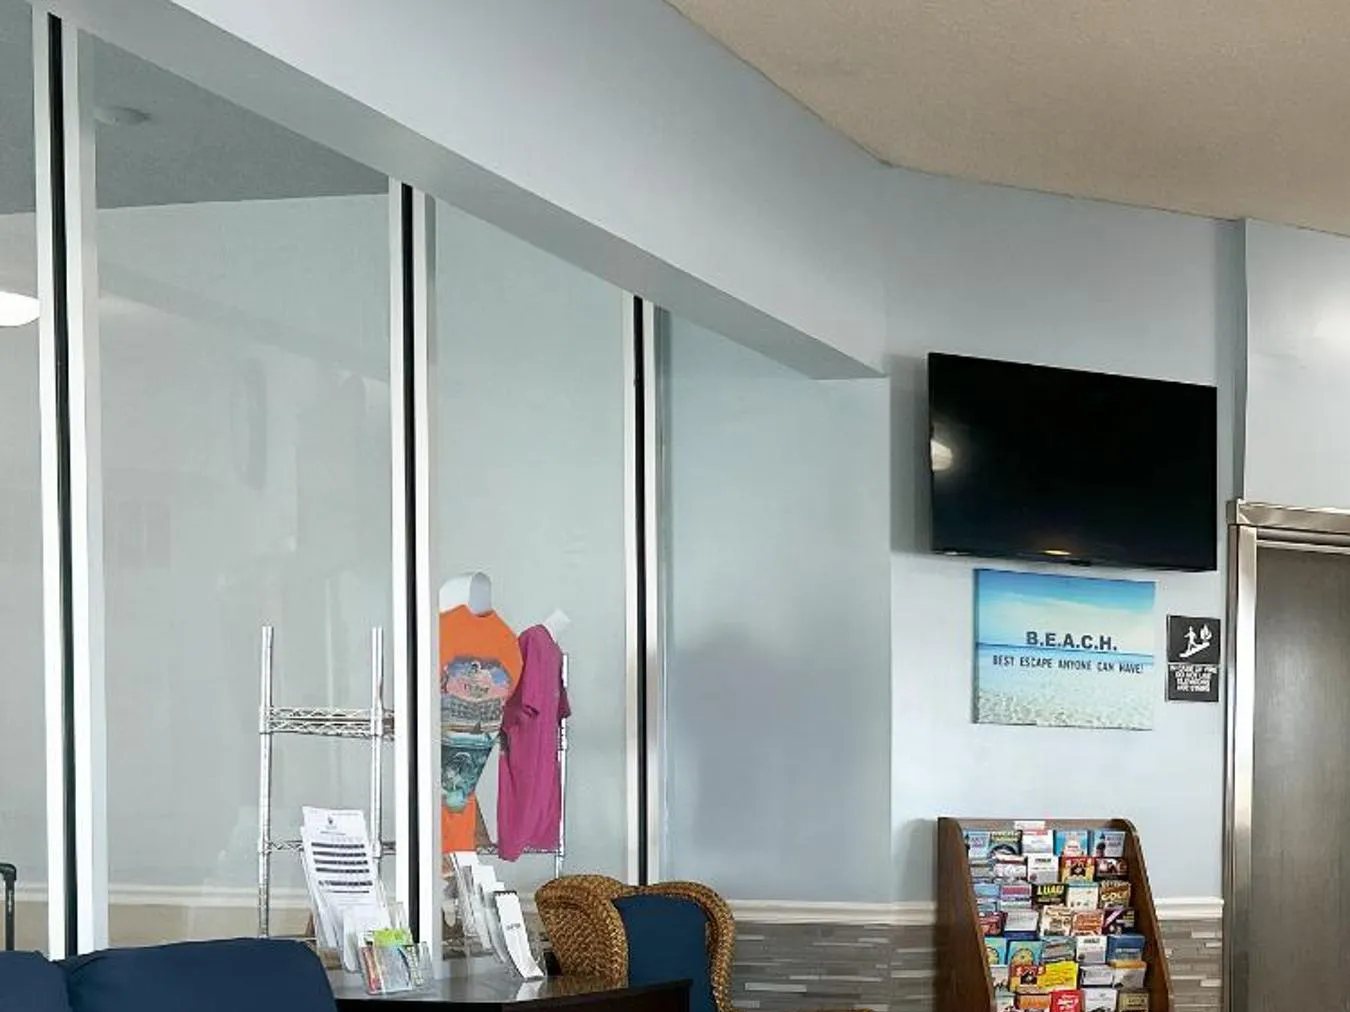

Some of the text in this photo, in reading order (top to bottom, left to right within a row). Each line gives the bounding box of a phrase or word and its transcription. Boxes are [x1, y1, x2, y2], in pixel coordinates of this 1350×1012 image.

[1026, 631, 1118, 651] B.E.A.C.H.
[993, 655, 1015, 666] BEST
[1020, 656, 1052, 669] ESCAPE
[1058, 660, 1092, 671] ANYONE
[1097, 662, 1115, 673] CAN
